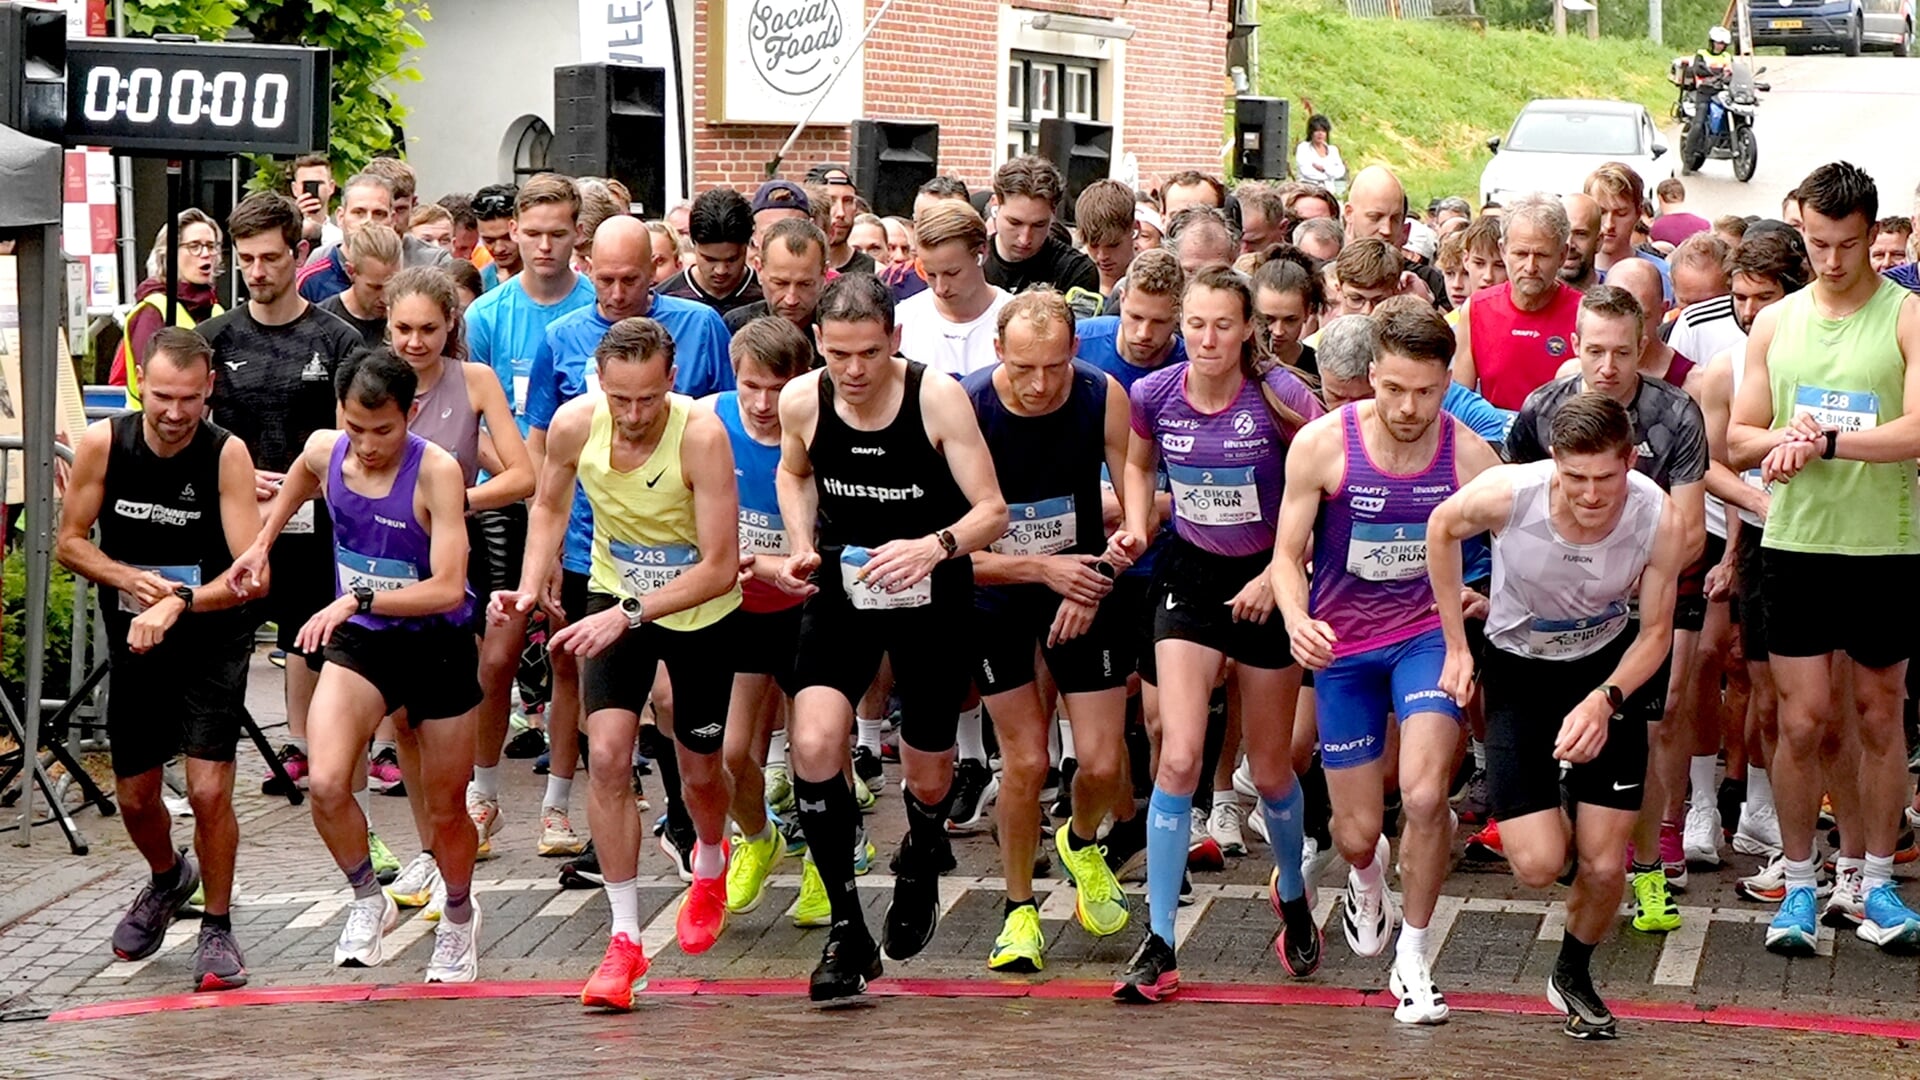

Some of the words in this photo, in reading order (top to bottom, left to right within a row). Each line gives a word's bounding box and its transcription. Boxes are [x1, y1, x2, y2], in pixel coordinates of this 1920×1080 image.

[764, 15, 840, 71] Foods
[84, 66, 289, 128] 0:00:00
[1821, 393, 1850, 409] 128
[1157, 418, 1190, 428] CRAFT
[1826, 413, 1861, 426] BIKE&
[851, 446, 878, 455] CRAFT
[1202, 471, 1214, 485] 2
[1203, 489, 1242, 499] BIKE&
[1347, 485, 1381, 496] CRAFT
[1213, 498, 1241, 507] RUN
[1351, 498, 1383, 511] RW
[152, 511, 187, 526] WORLD
[739, 510, 768, 525] 185
[1025, 506, 1037, 519] 8
[375, 514, 407, 530] KIPRUN
[1025, 520, 1063, 533] BIKE&
[747, 528, 784, 542] BIKE&
[1034, 529, 1062, 541] RUN
[1394, 527, 1405, 540] 1
[754, 537, 782, 550] RUN
[634, 549, 666, 564] 243
[1397, 553, 1426, 563] RUN
[1563, 554, 1593, 564] FUSION
[366, 560, 377, 574] 7
[1575, 618, 1587, 630] 3
[1324, 738, 1366, 752] CRAFT
